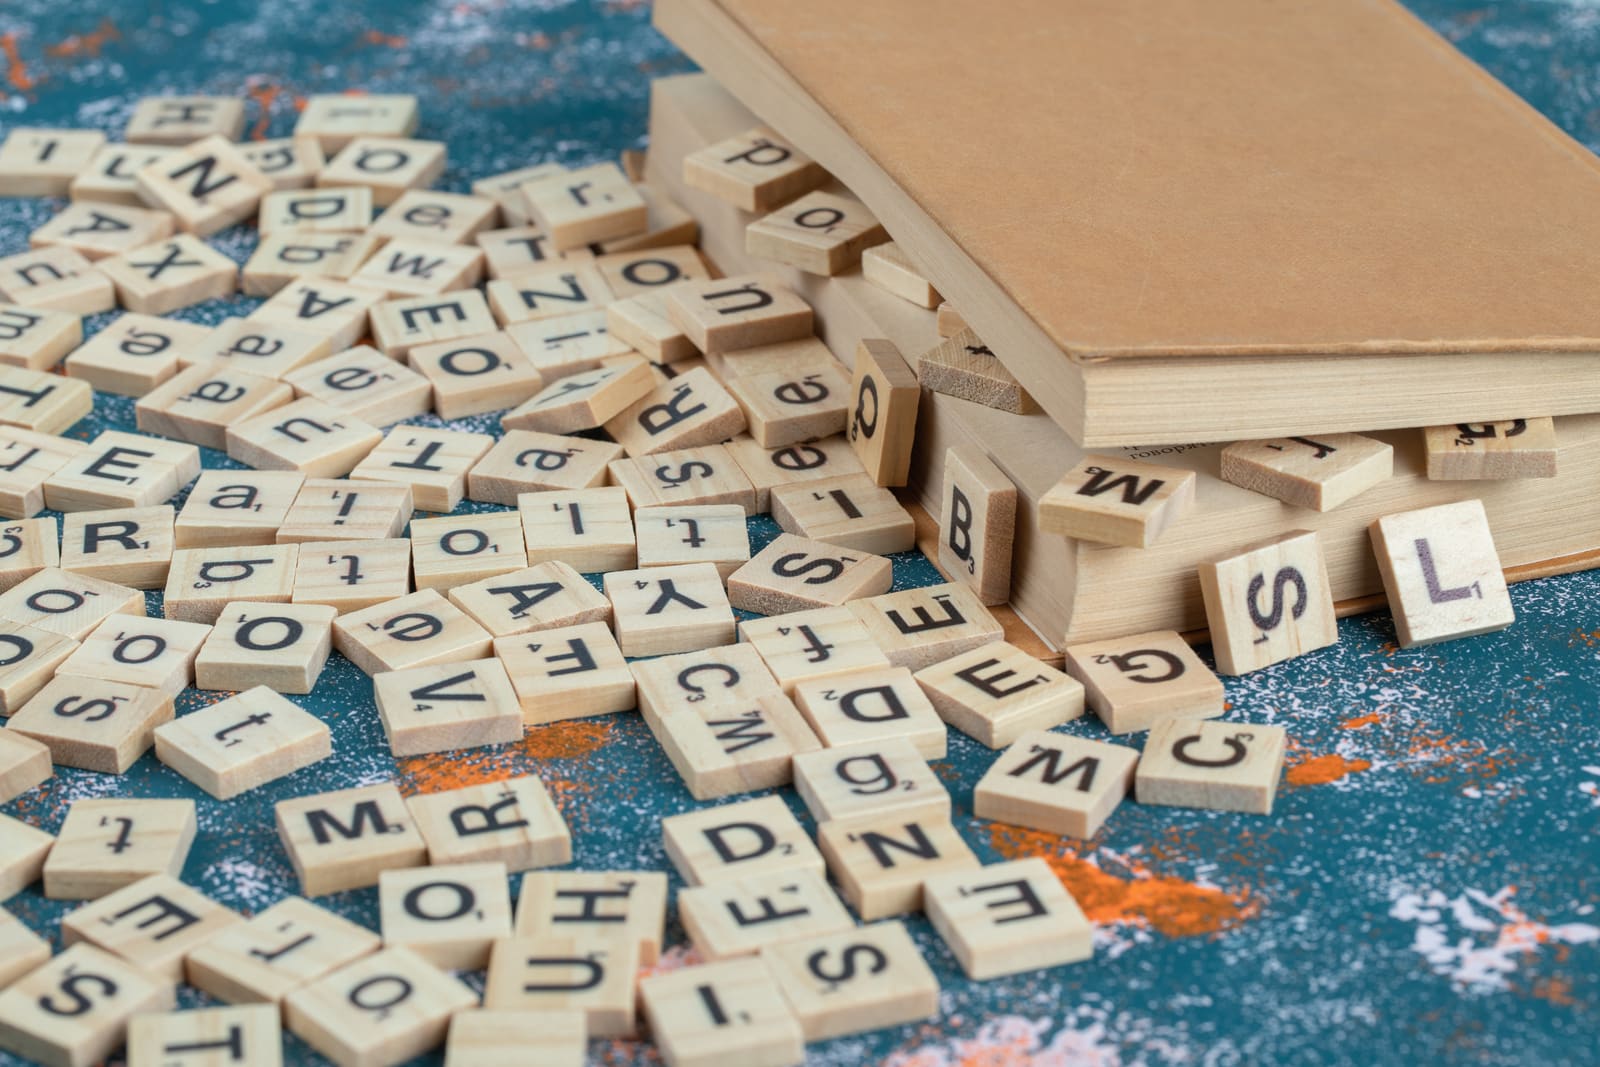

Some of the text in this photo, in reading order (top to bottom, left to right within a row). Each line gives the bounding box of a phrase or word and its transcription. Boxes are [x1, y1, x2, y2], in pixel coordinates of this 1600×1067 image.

[169, 156, 238, 198] N
[67, 211, 131, 233] A
[297, 290, 356, 319] A
[400, 301, 467, 329] E
[120, 331, 172, 356] e
[230, 335, 284, 356] a
[190, 381, 246, 403] a
[324, 367, 379, 391] e
[774, 381, 830, 404] e
[638, 387, 707, 436] R
[273, 417, 332, 442] n
[81, 447, 155, 481] E
[390, 441, 444, 471] T
[516, 449, 573, 471] a
[772, 447, 828, 471] e
[210, 484, 258, 509] a
[83, 521, 141, 554] R
[677, 518, 706, 548] t
[949, 485, 972, 561] B
[340, 555, 364, 585] t
[1414, 538, 1472, 604] L
[486, 582, 565, 616] A
[645, 579, 708, 615] Y
[1247, 566, 1308, 631] S
[383, 613, 443, 642] e
[885, 600, 968, 635] E
[545, 638, 598, 677] F
[797, 625, 835, 663] f
[954, 658, 1041, 699] E
[1111, 649, 1186, 683] G
[839, 685, 910, 723] D
[214, 712, 273, 742] t
[836, 753, 898, 795] g
[450, 797, 530, 837] R
[106, 817, 133, 854] t
[703, 822, 777, 864] D
[860, 823, 942, 868] N
[114, 894, 203, 942] E
[552, 890, 630, 922] H
[971, 879, 1048, 924] E
[164, 1024, 244, 1061] T
